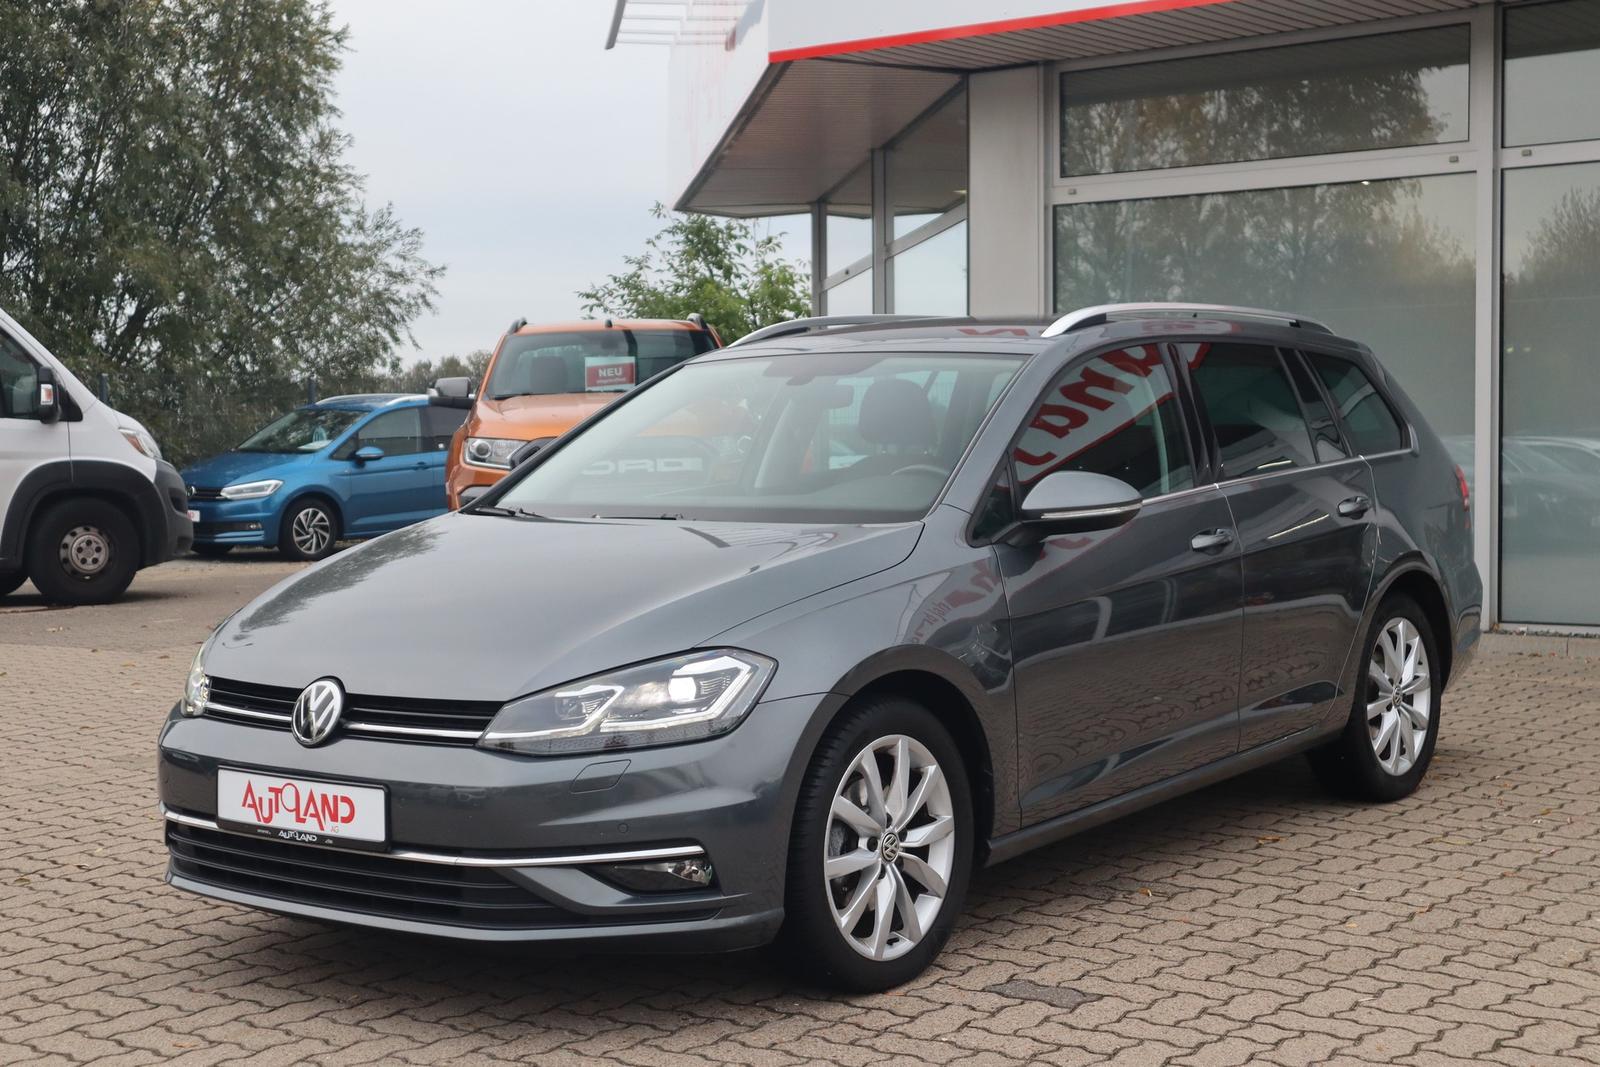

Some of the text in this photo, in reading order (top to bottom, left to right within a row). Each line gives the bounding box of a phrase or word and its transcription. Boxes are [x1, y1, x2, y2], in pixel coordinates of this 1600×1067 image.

[598, 368, 623, 377] NEU
[242, 780, 355, 831] AUTOLAND
[278, 830, 318, 842] AUTOLAND
